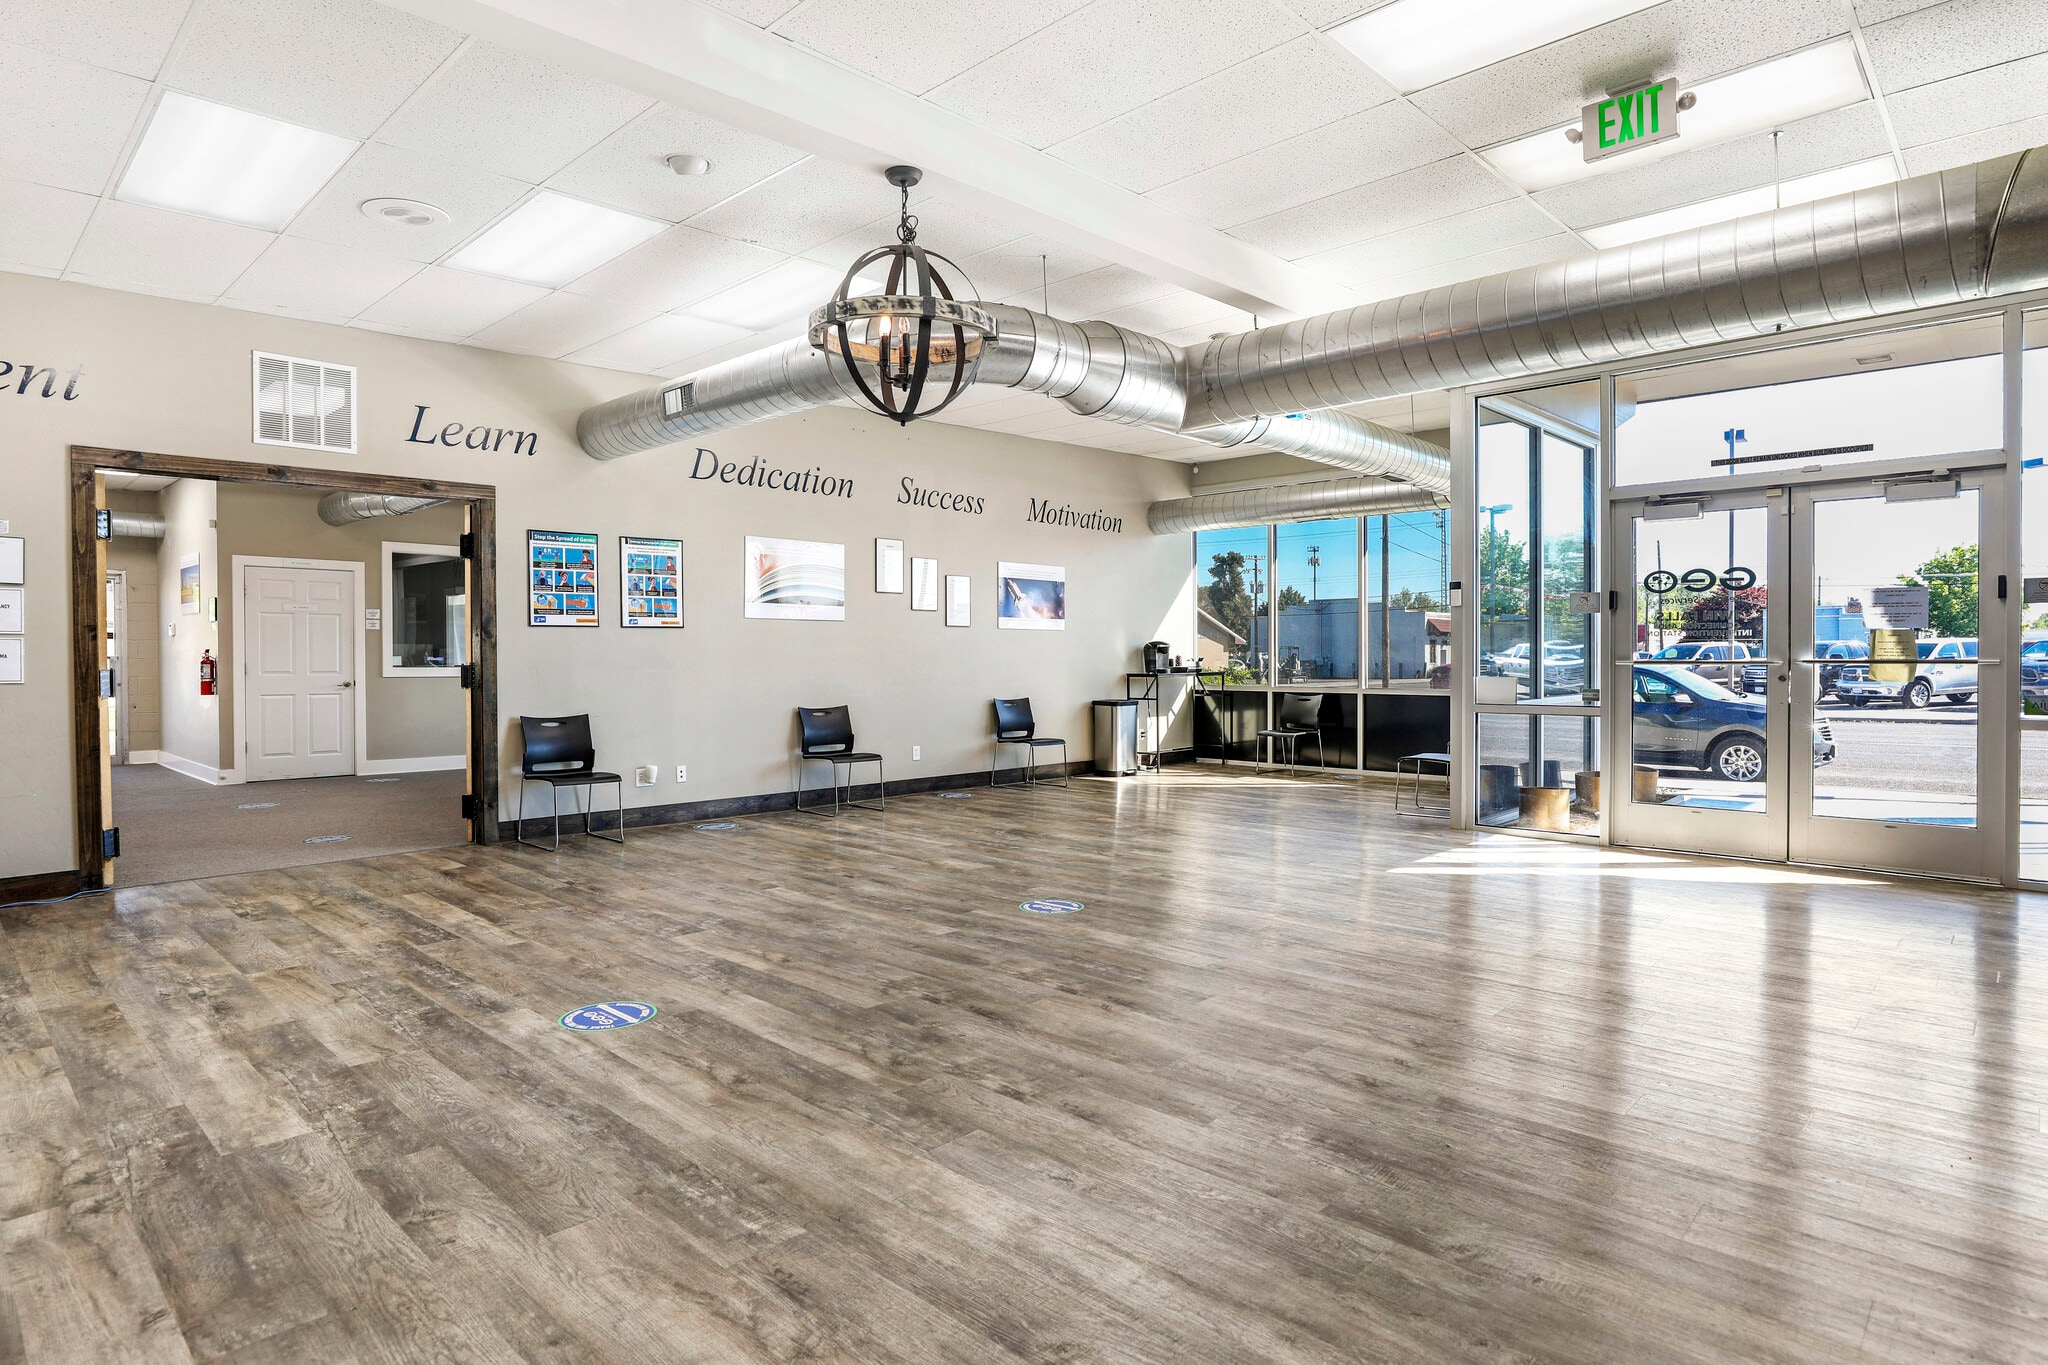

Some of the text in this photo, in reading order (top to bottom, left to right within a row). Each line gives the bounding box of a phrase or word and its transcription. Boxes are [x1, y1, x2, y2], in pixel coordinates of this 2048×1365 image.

[1598, 84, 1663, 149] EXIT
[404, 404, 538, 456] Learn
[688, 447, 854, 499] Dedication
[897, 476, 985, 515] Success
[534, 533, 546, 541] Stop
[1026, 497, 1123, 534] Motivation
